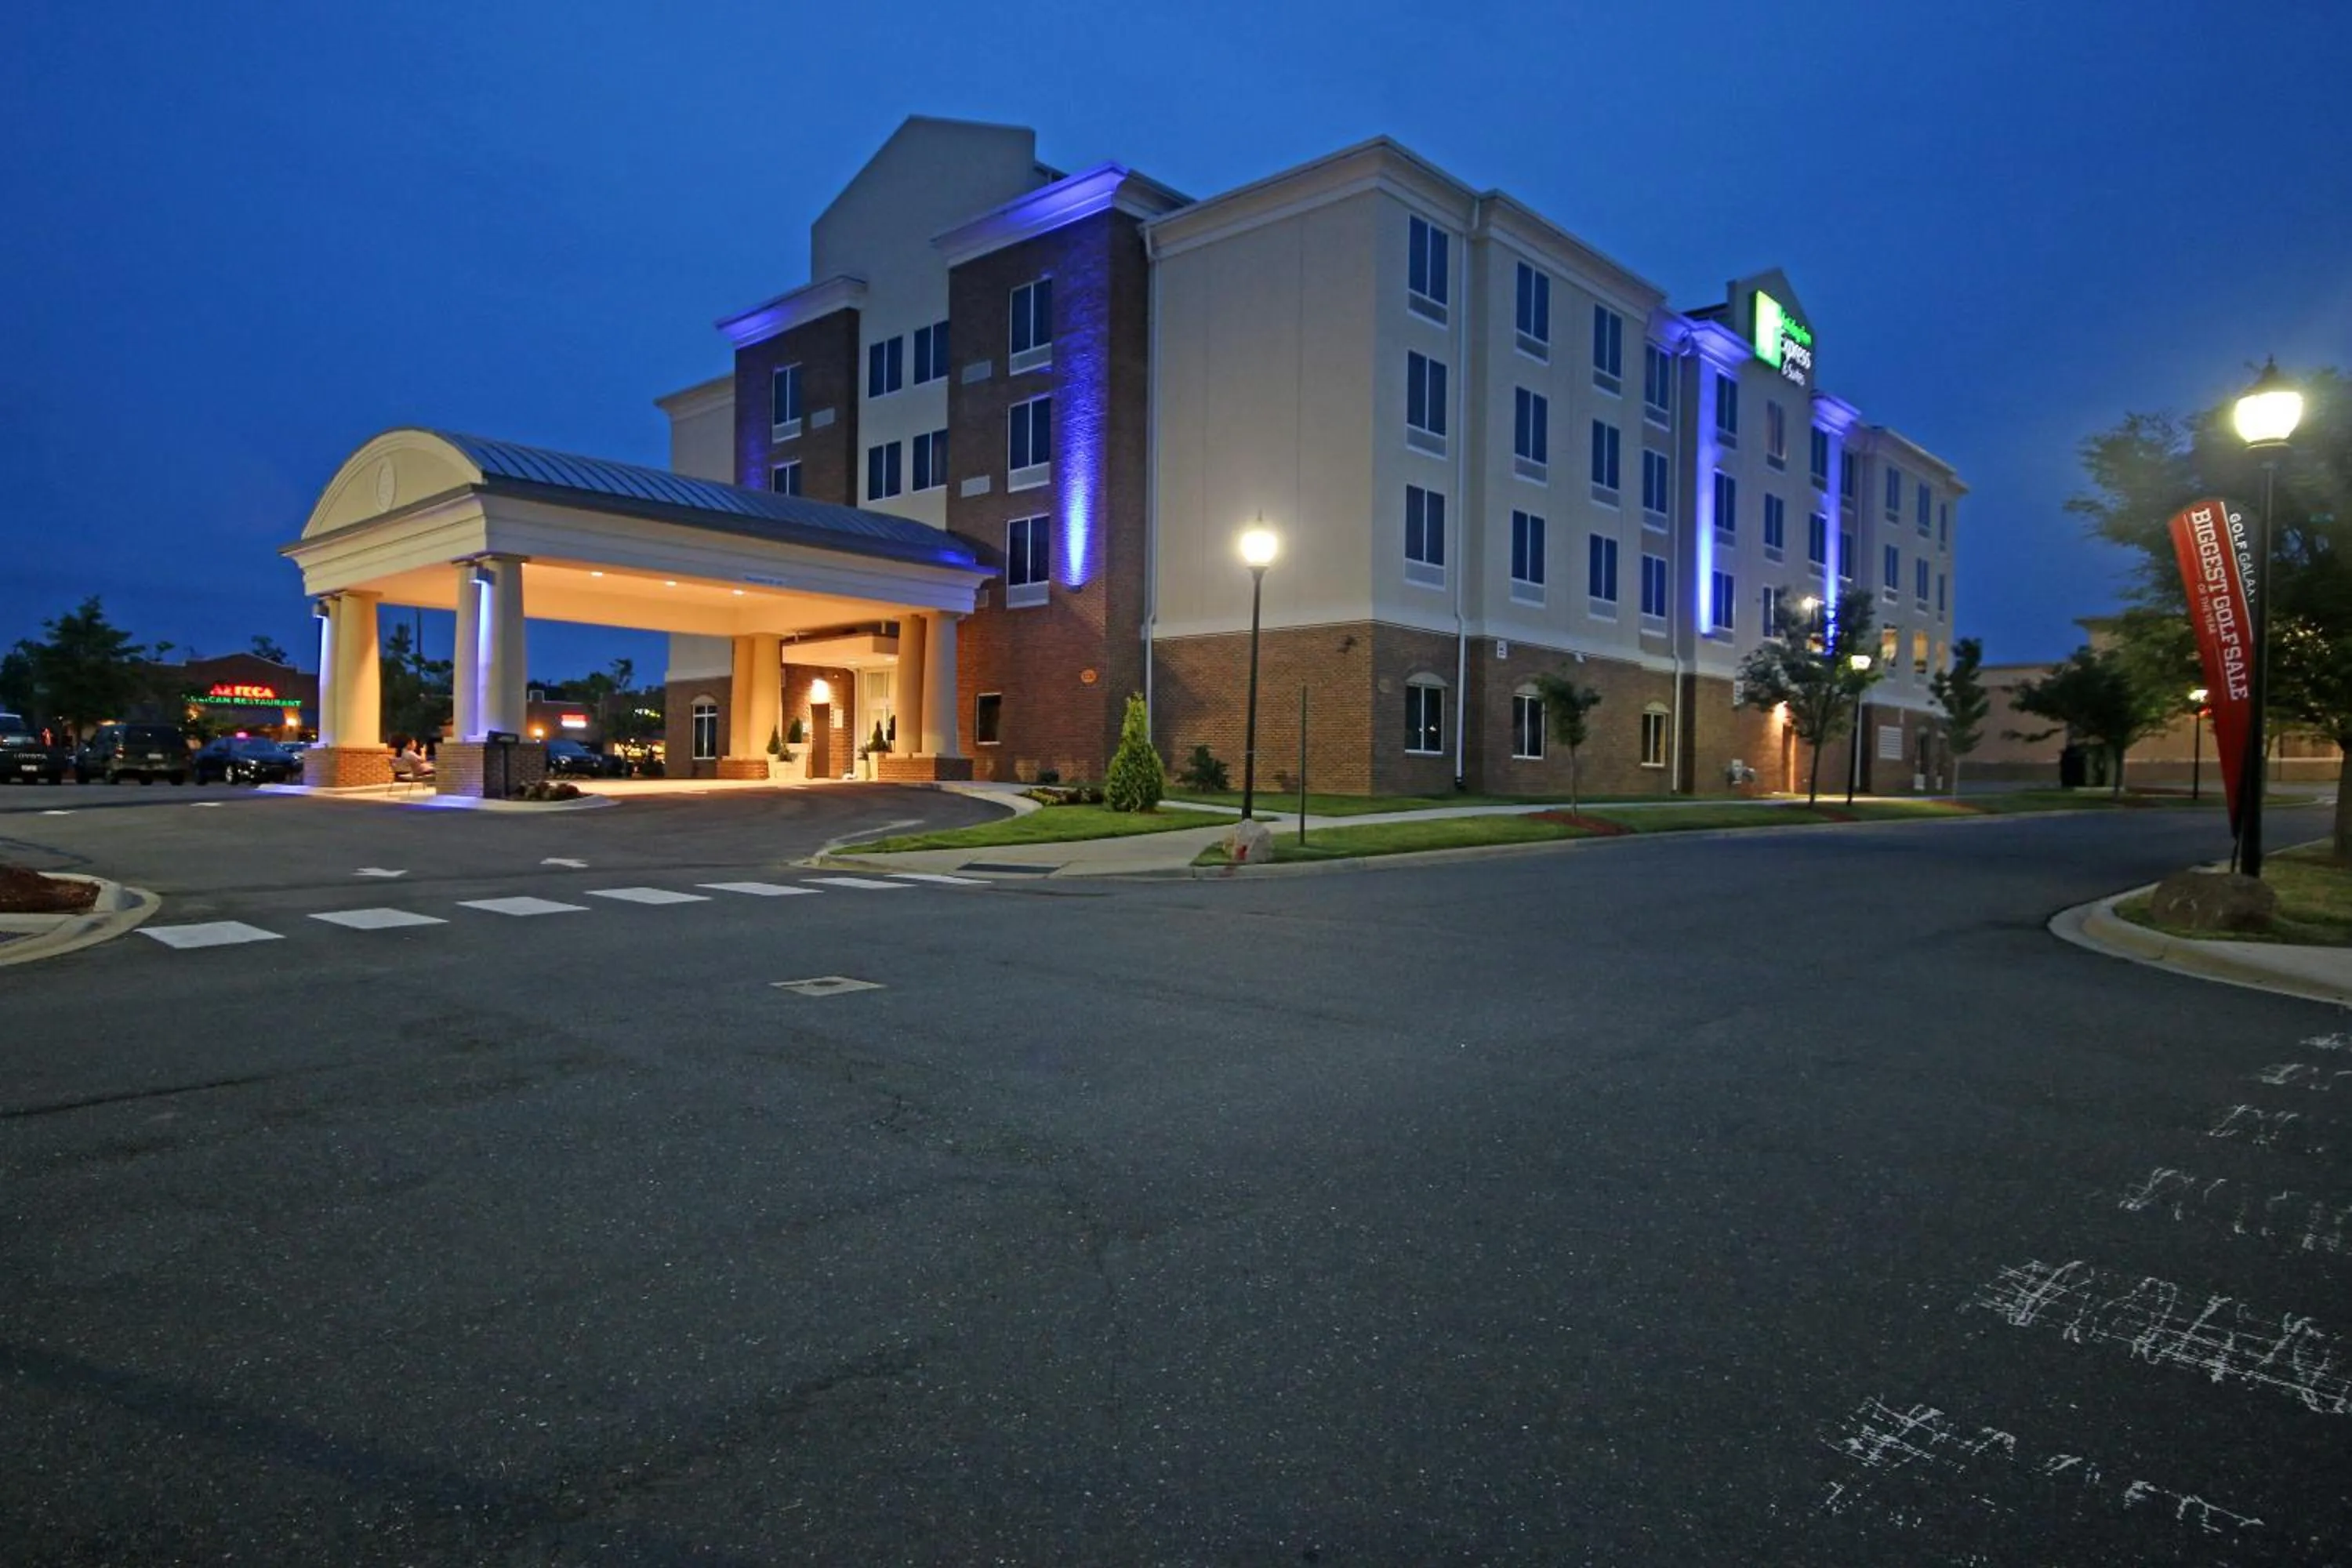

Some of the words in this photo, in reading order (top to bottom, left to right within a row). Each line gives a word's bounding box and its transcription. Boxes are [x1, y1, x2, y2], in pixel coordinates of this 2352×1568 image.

[2190, 508, 2228, 593] BIGGEST
[2229, 512, 2248, 550] GOLF
[2238, 552, 2256, 604] GALA
[2212, 595, 2239, 644] GOLF
[2223, 645, 2249, 701] SALE
